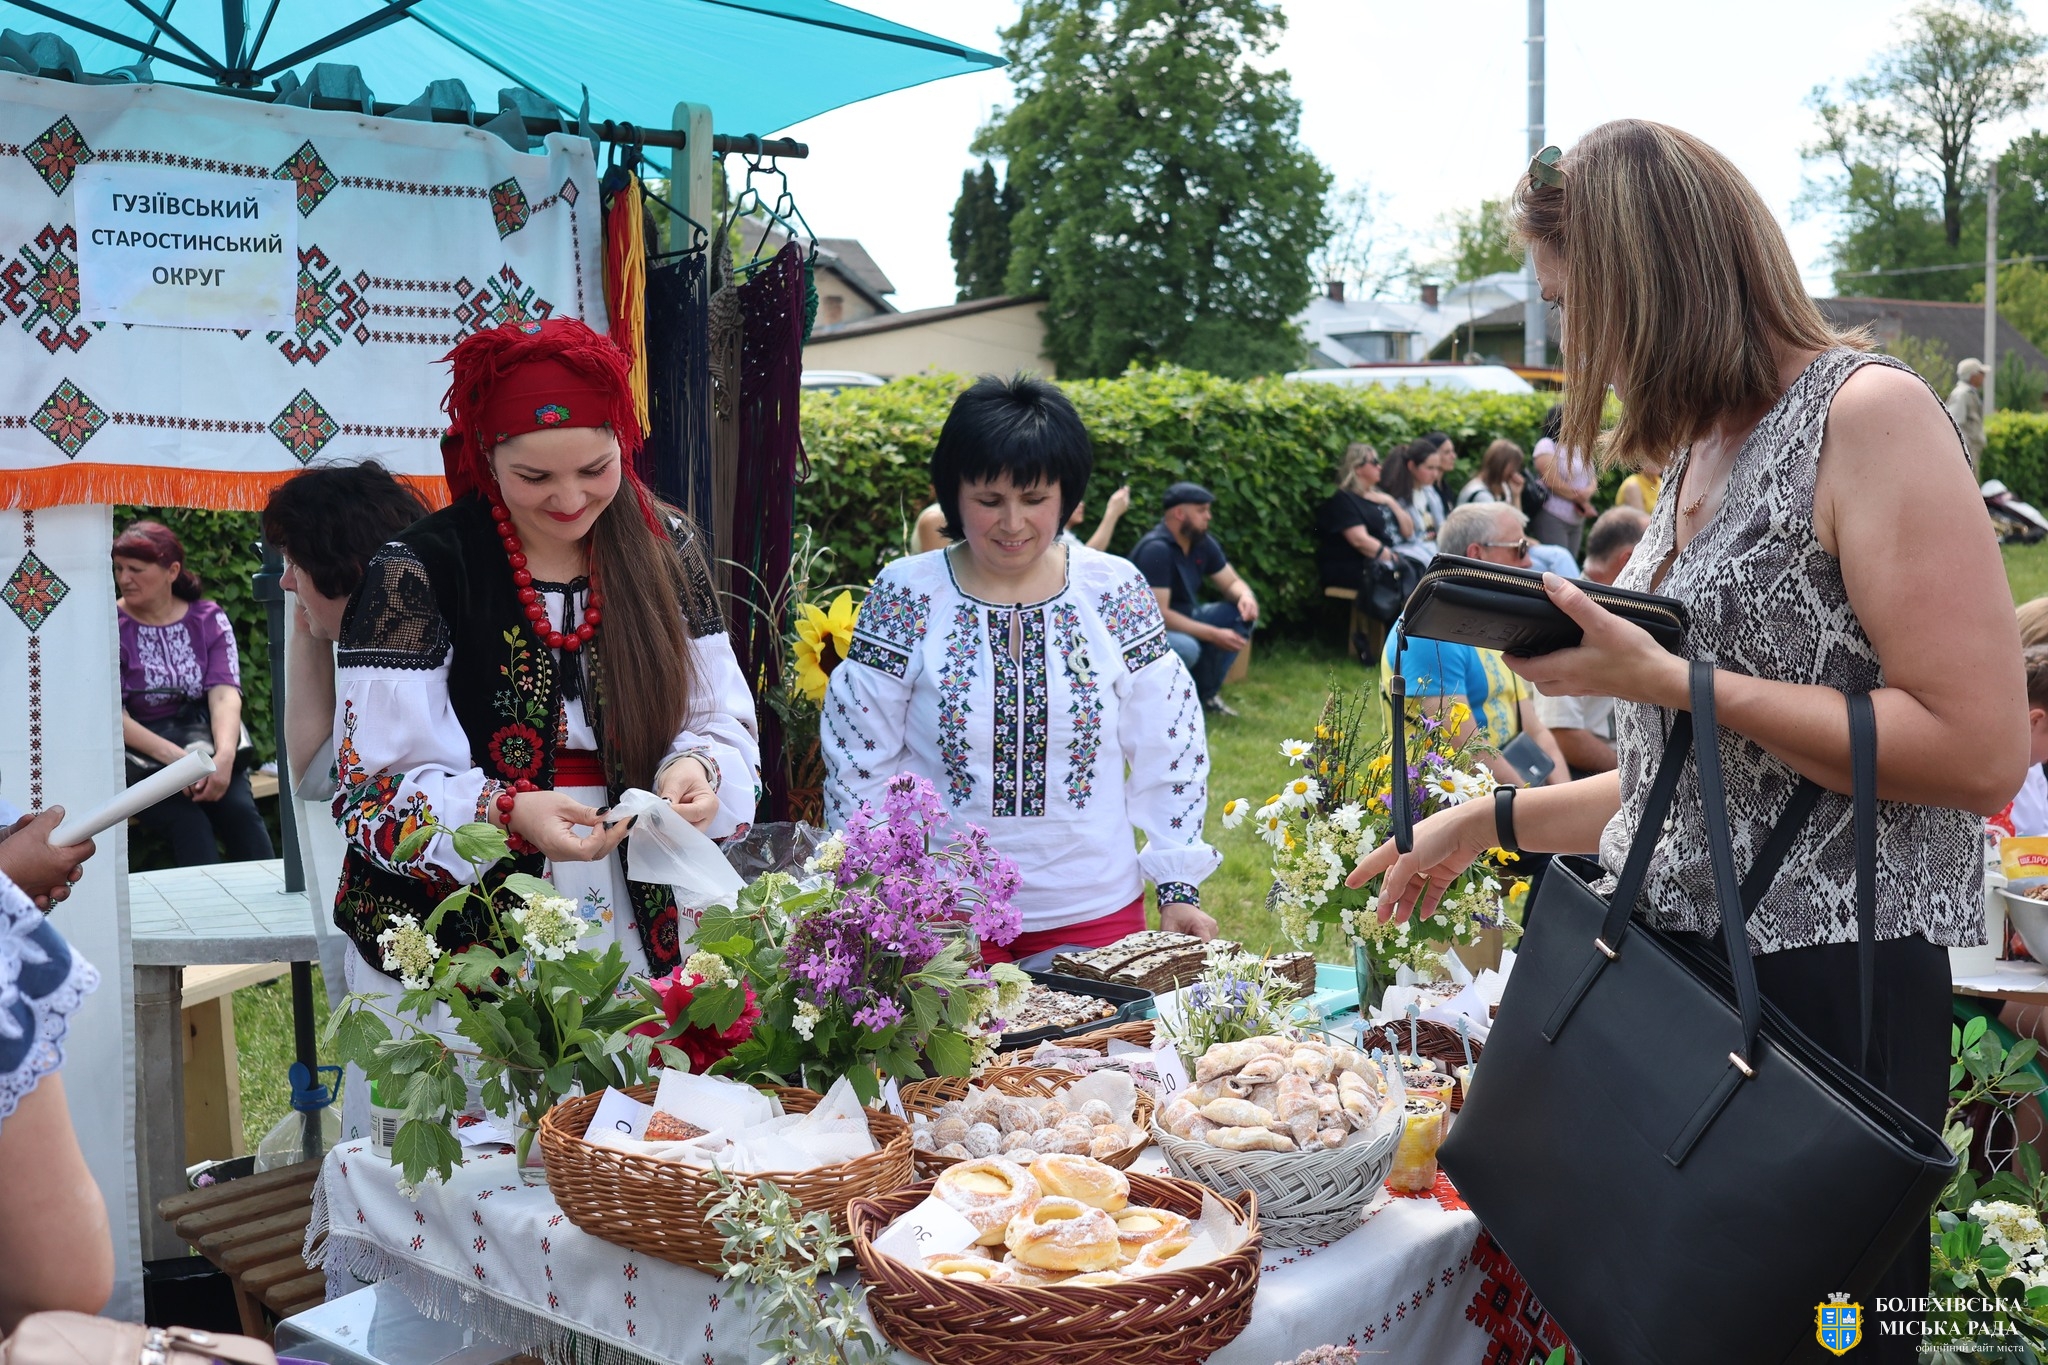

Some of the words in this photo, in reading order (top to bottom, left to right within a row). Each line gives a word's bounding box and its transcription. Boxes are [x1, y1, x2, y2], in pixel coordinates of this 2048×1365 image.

[112, 191, 259, 219] ГУЗІЇВСЬКИЙ
[91, 228, 283, 254] СТАРОСТИНСЬКИЙ
[152, 266, 226, 287] ОКРУГ
[1162, 1073, 1177, 1095] 10
